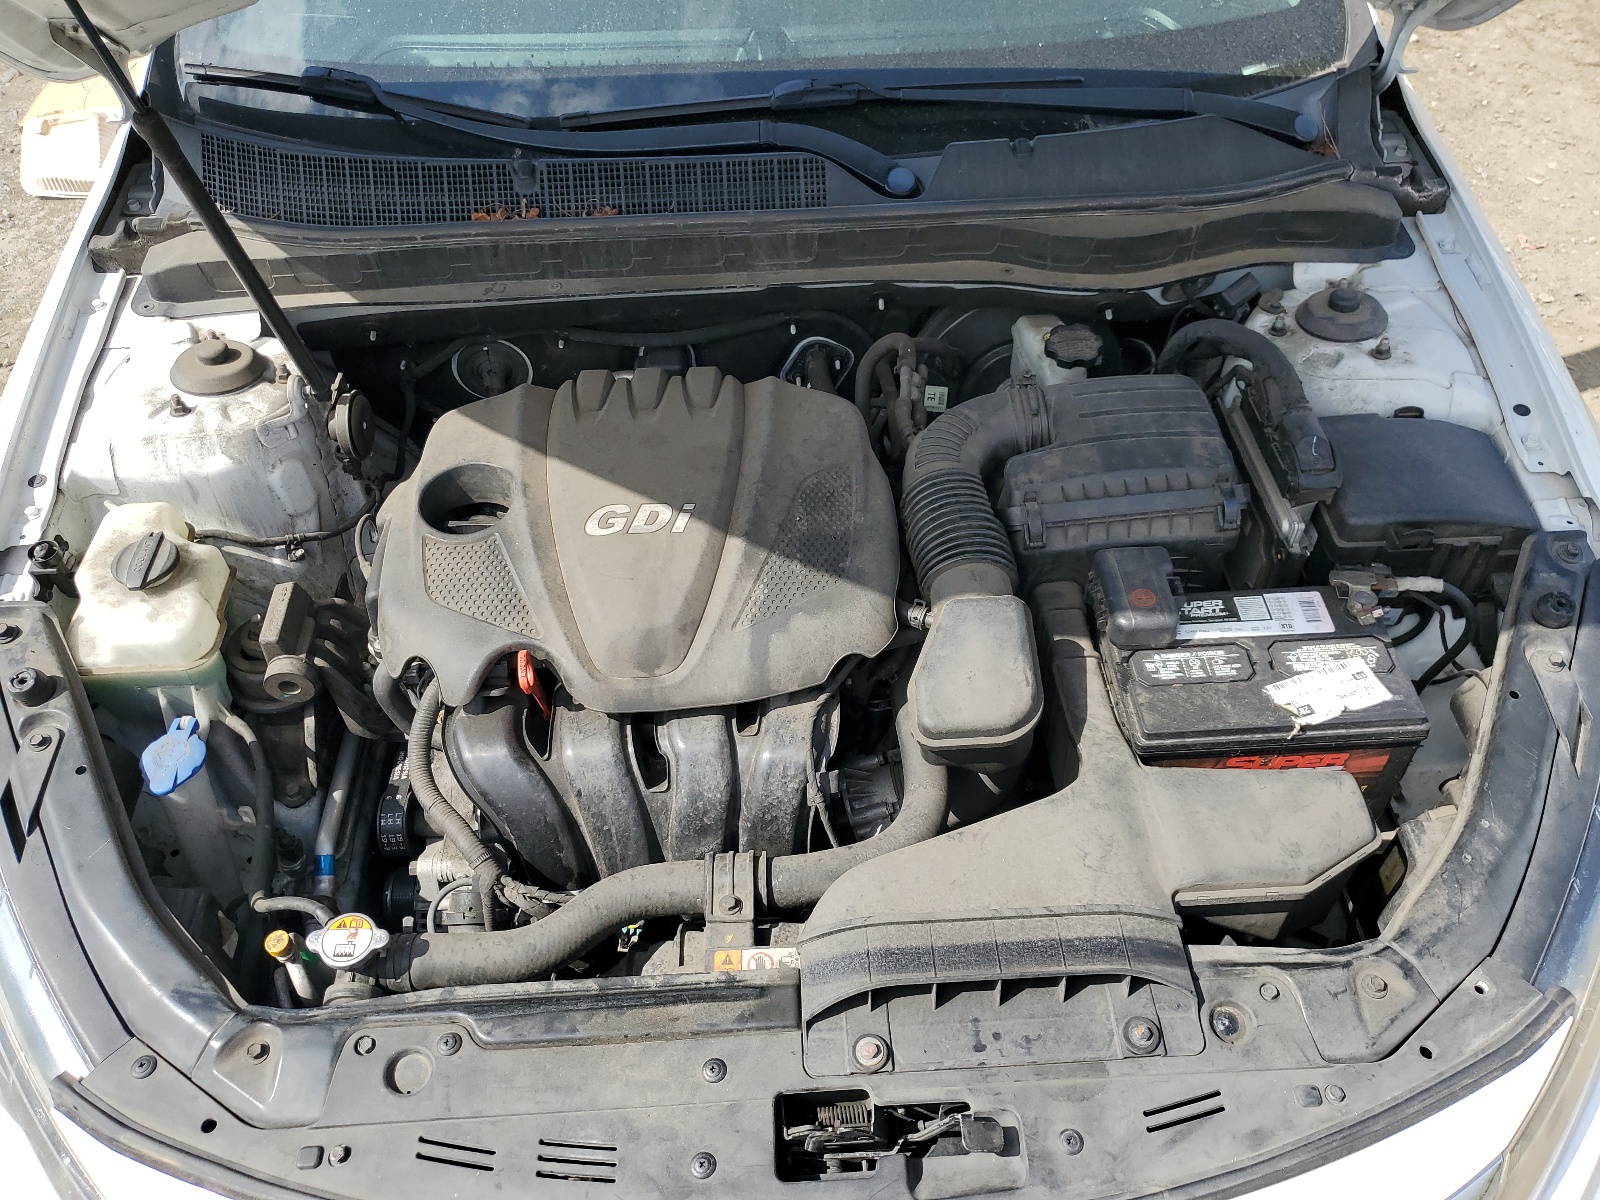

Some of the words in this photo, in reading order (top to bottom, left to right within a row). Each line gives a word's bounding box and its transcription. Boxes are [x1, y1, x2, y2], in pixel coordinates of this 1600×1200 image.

[927, 392, 936, 402] TE
[584, 503, 696, 536] GDi
[1183, 599, 1223, 608] UPER
[1179, 605, 1226, 616] TART
[1226, 753, 1350, 770] SUPER
